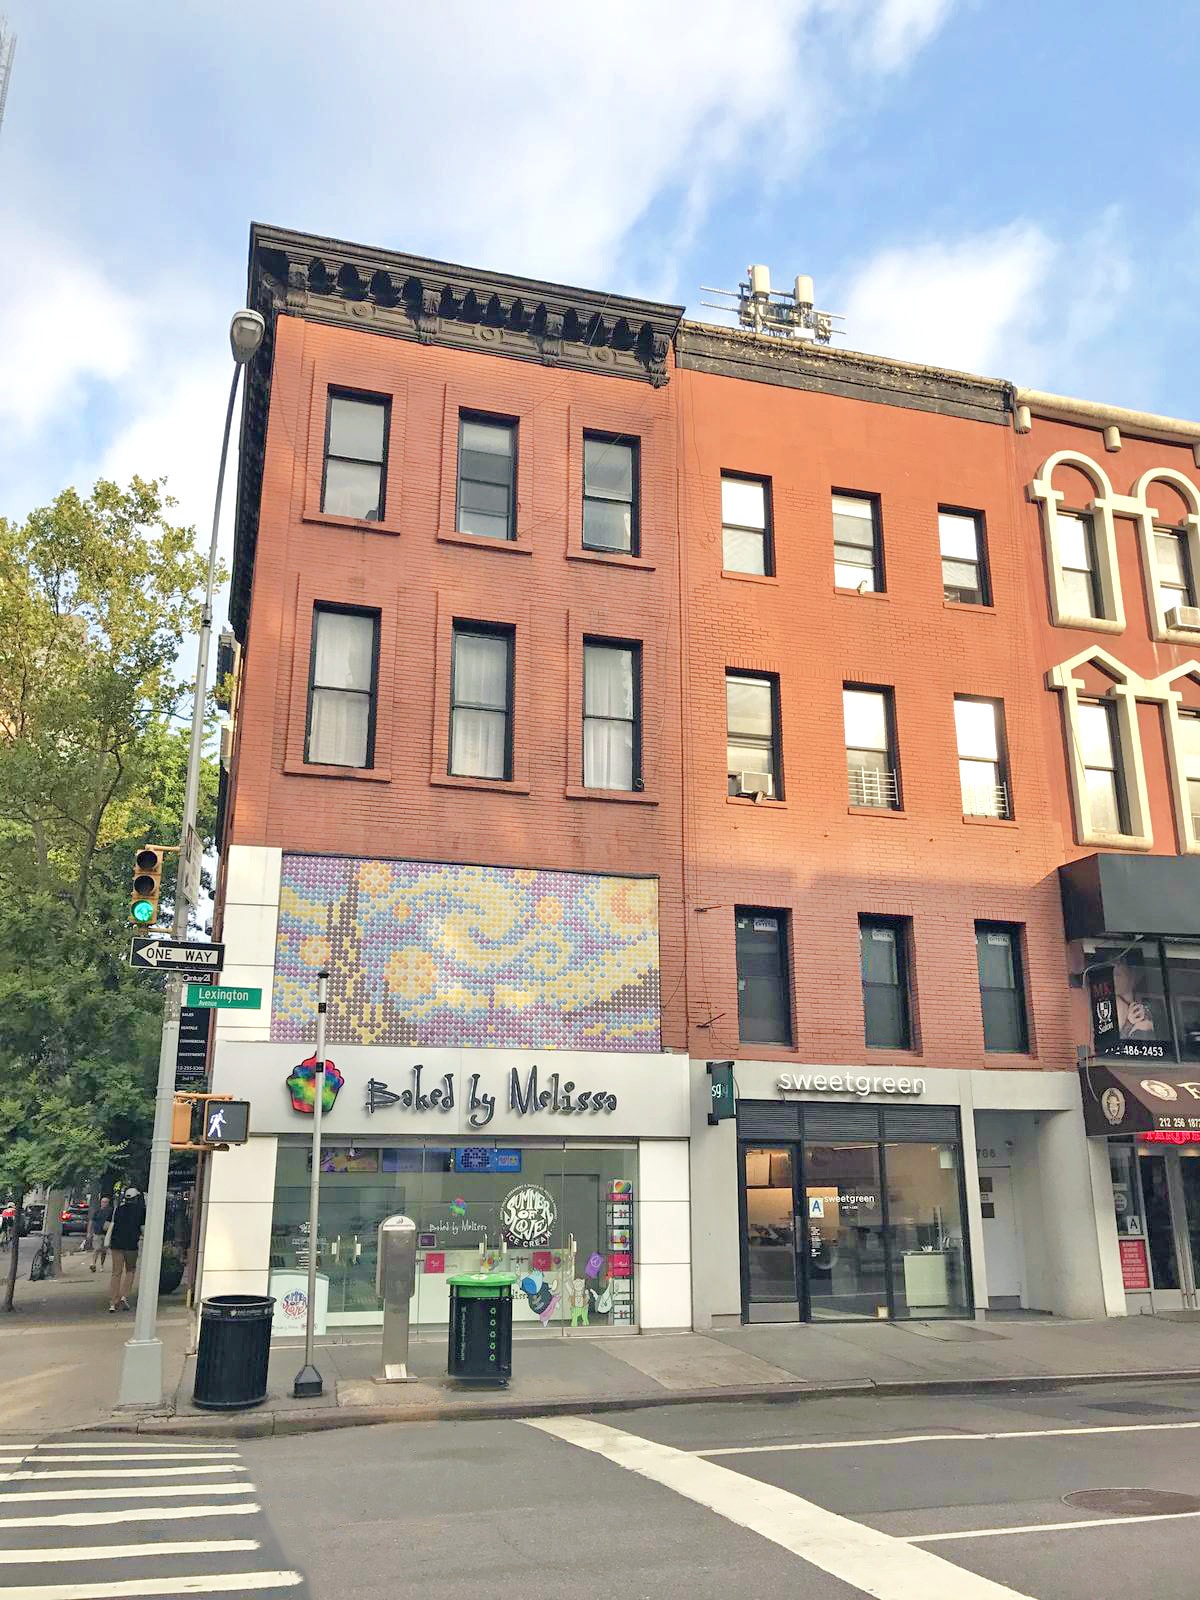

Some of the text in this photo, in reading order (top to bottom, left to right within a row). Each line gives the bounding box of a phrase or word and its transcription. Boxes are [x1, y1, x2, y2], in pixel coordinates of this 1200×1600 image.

[147, 948, 213, 963] ONE WAY
[199, 987, 249, 1003] Lexington
[712, 1083, 722, 1097] sg
[779, 1071, 926, 1096] sweetgreen
[365, 1064, 618, 1127] Baked by Melissa
[1159, 1117, 1171, 1128] 212
[1173, 1117, 1185, 1128] 256
[503, 1187, 554, 1227] SUMMER
[812, 1200, 822, 1213] A
[824, 1195, 875, 1204] sweetgreen
[517, 1210, 539, 1220] OF
[429, 1219, 488, 1235] Baked by Melissa
[1129, 1218, 1138, 1230] A
[506, 1231, 552, 1248] ICE CREAM
